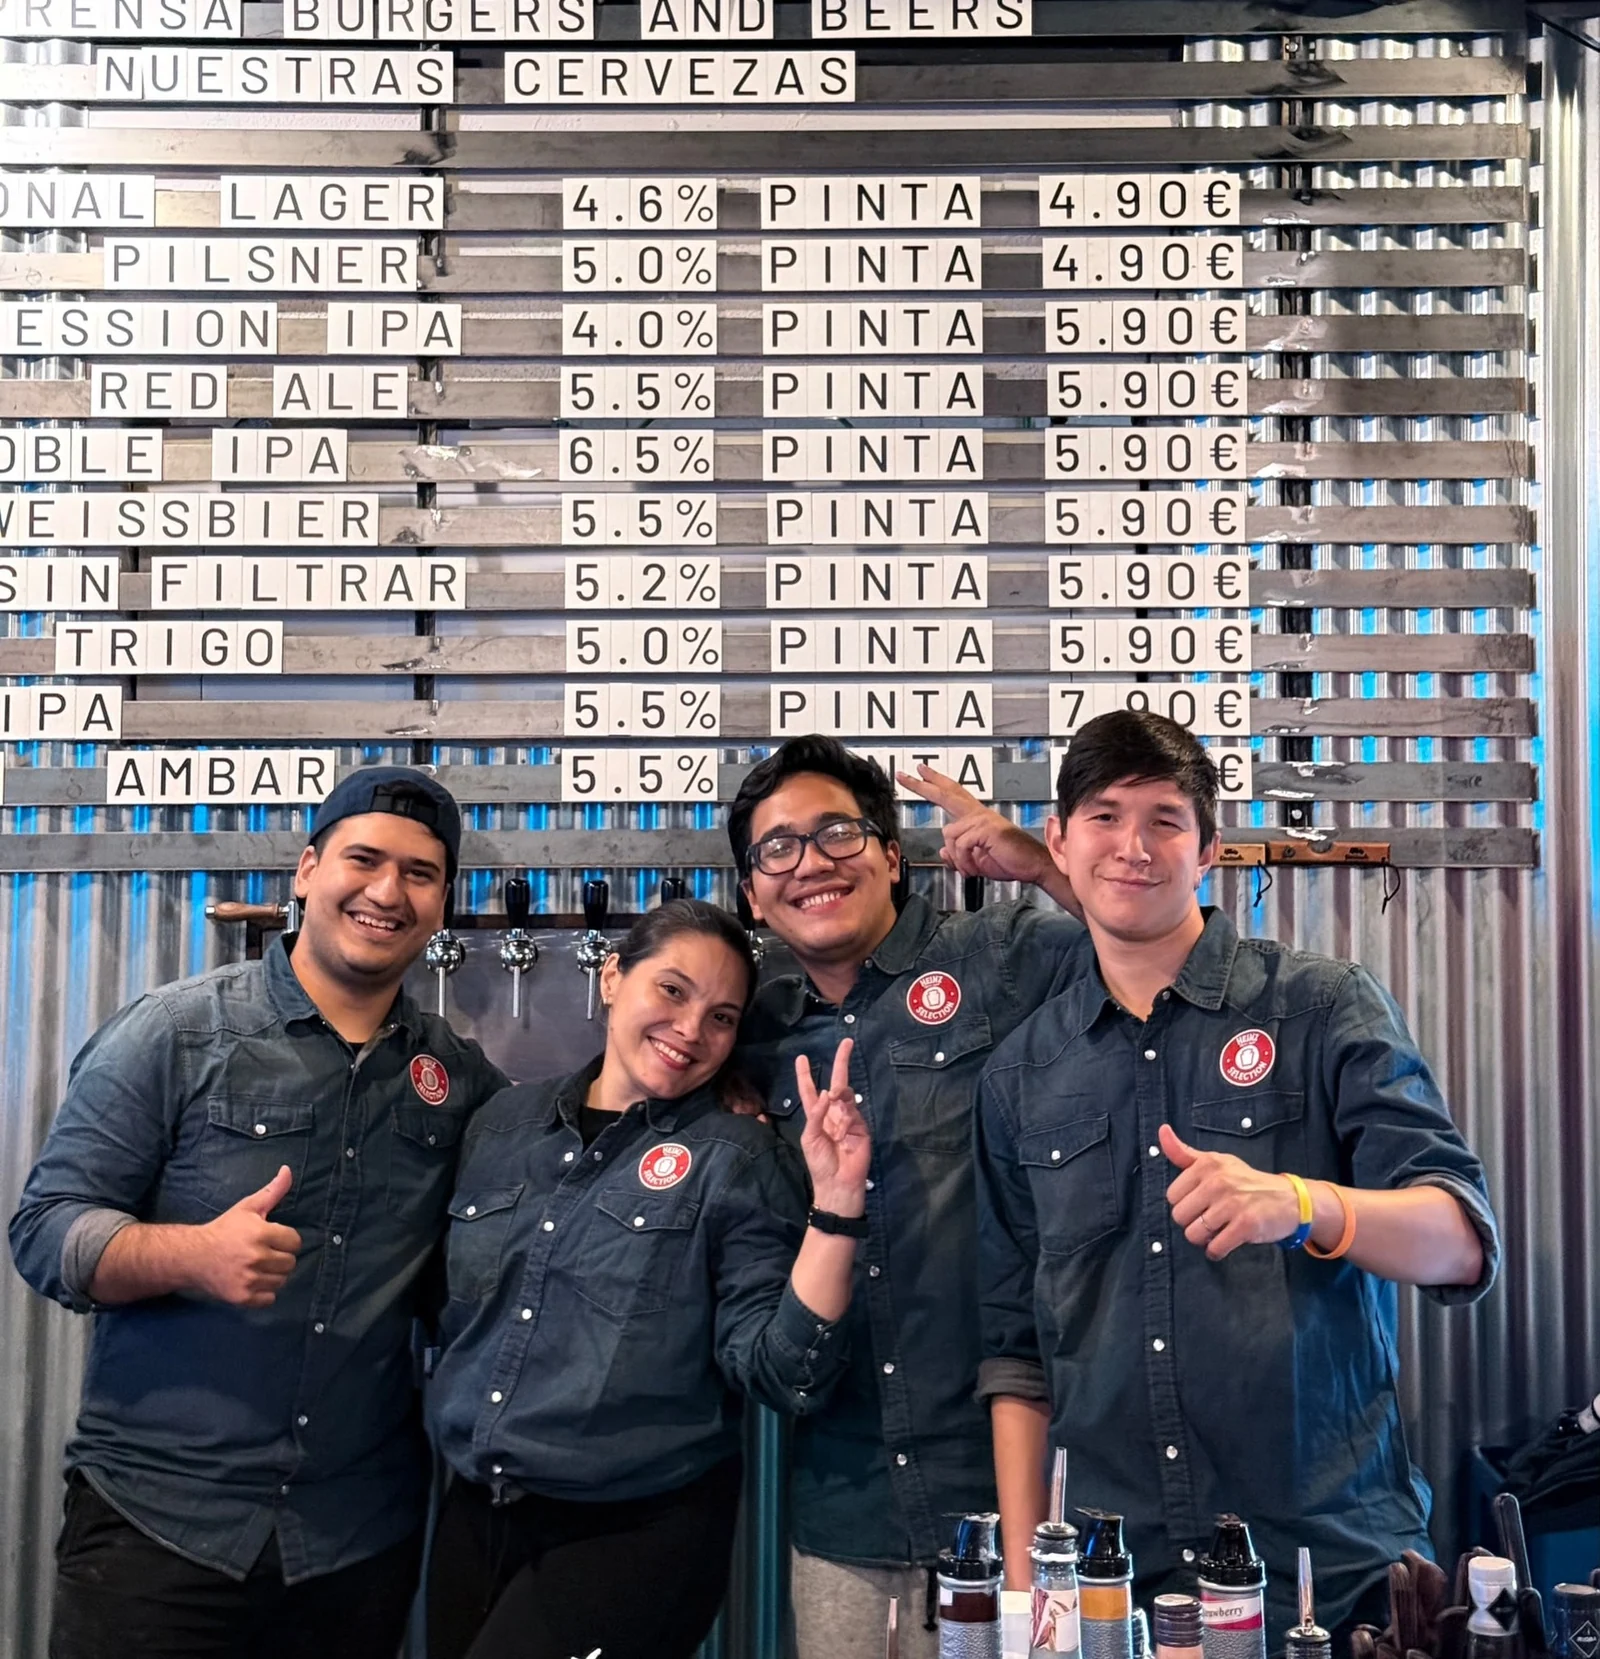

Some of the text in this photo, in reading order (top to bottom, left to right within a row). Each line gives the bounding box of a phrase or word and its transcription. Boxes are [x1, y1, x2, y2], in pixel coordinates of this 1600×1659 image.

[0, 0, 1022, 33] RENSA BURGERS AND BEERS
[107, 56, 846, 95] NUESTRAS CERVEZAS
[232, 184, 433, 220] LAGER
[573, 185, 713, 222] 4.6%
[771, 184, 973, 221] PINTA
[1050, 181, 1230, 218] 4.90€
[115, 243, 1233, 284] PILSNER 5.0% PINTA 4.90€
[18, 307, 1237, 348] ESSION IPA 4.0% PINTA 5.90€
[101, 371, 1238, 410] RED ALE 5.5% PINTA 5.90€
[233, 437, 338, 473] IPA
[571, 436, 709, 474] 6.5%
[773, 436, 975, 473] PINTA
[1057, 434, 1237, 472] 5.90€
[573, 500, 712, 537] 5.5%
[777, 499, 981, 537] PINTA
[1057, 498, 1236, 536] 5.90€
[162, 564, 456, 601] FILTRAR
[577, 564, 715, 601] 5.2%
[776, 563, 980, 600] PINTA
[1060, 562, 1241, 600] 5.90€
[66, 626, 1242, 666] TRIGO 5.0% PINTA 5.90€
[4, 690, 1241, 732] IPA 5.5% PINTA 790€
[115, 757, 325, 796] AMBAR
[573, 756, 713, 793] 5.5%
